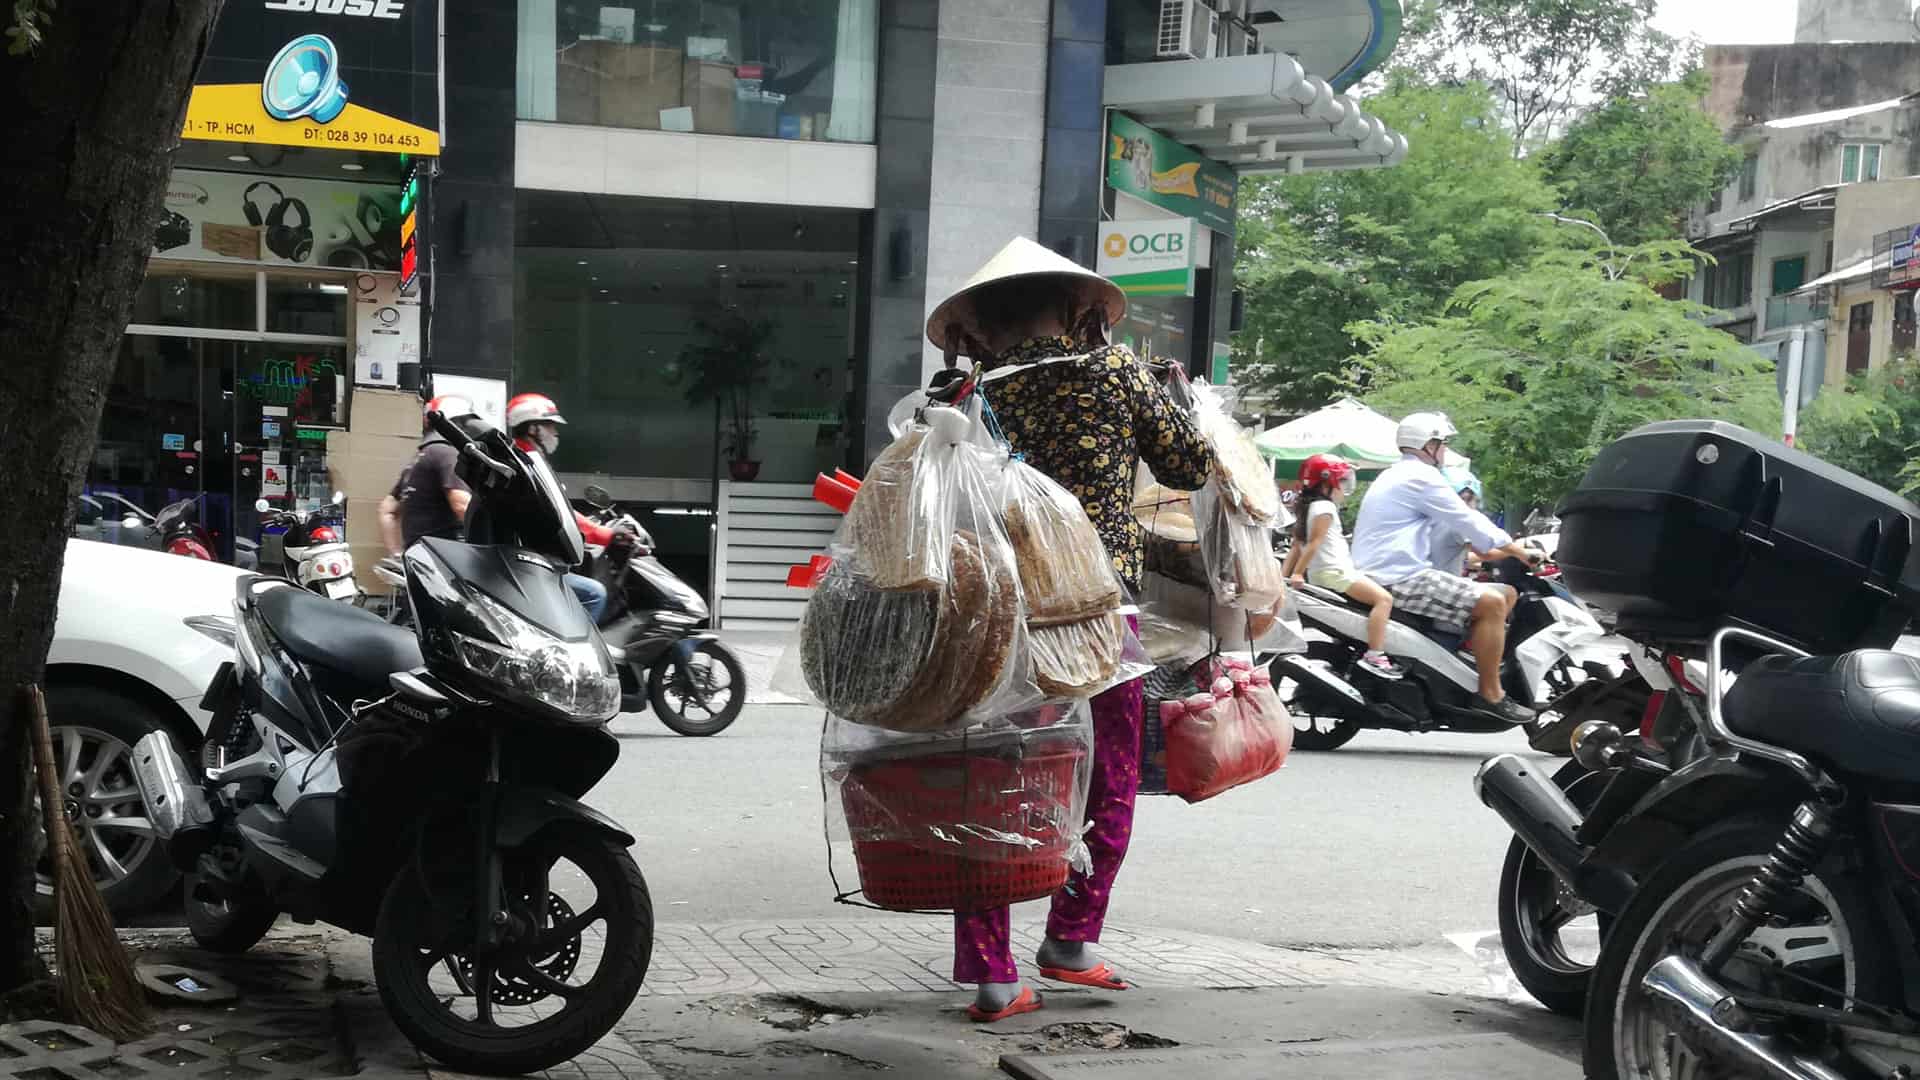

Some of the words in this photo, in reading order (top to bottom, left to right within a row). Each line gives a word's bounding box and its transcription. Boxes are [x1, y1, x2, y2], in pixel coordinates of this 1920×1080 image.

[226, 123, 255, 136] HCM
[304, 128, 323, 140] ĐT:
[327, 130, 350, 142] 028
[353, 131, 368, 143] 39
[373, 133, 394, 145] 104
[398, 135, 420, 147] 453
[1128, 233, 1184, 254] OCB
[392, 700, 430, 722] HONDA
